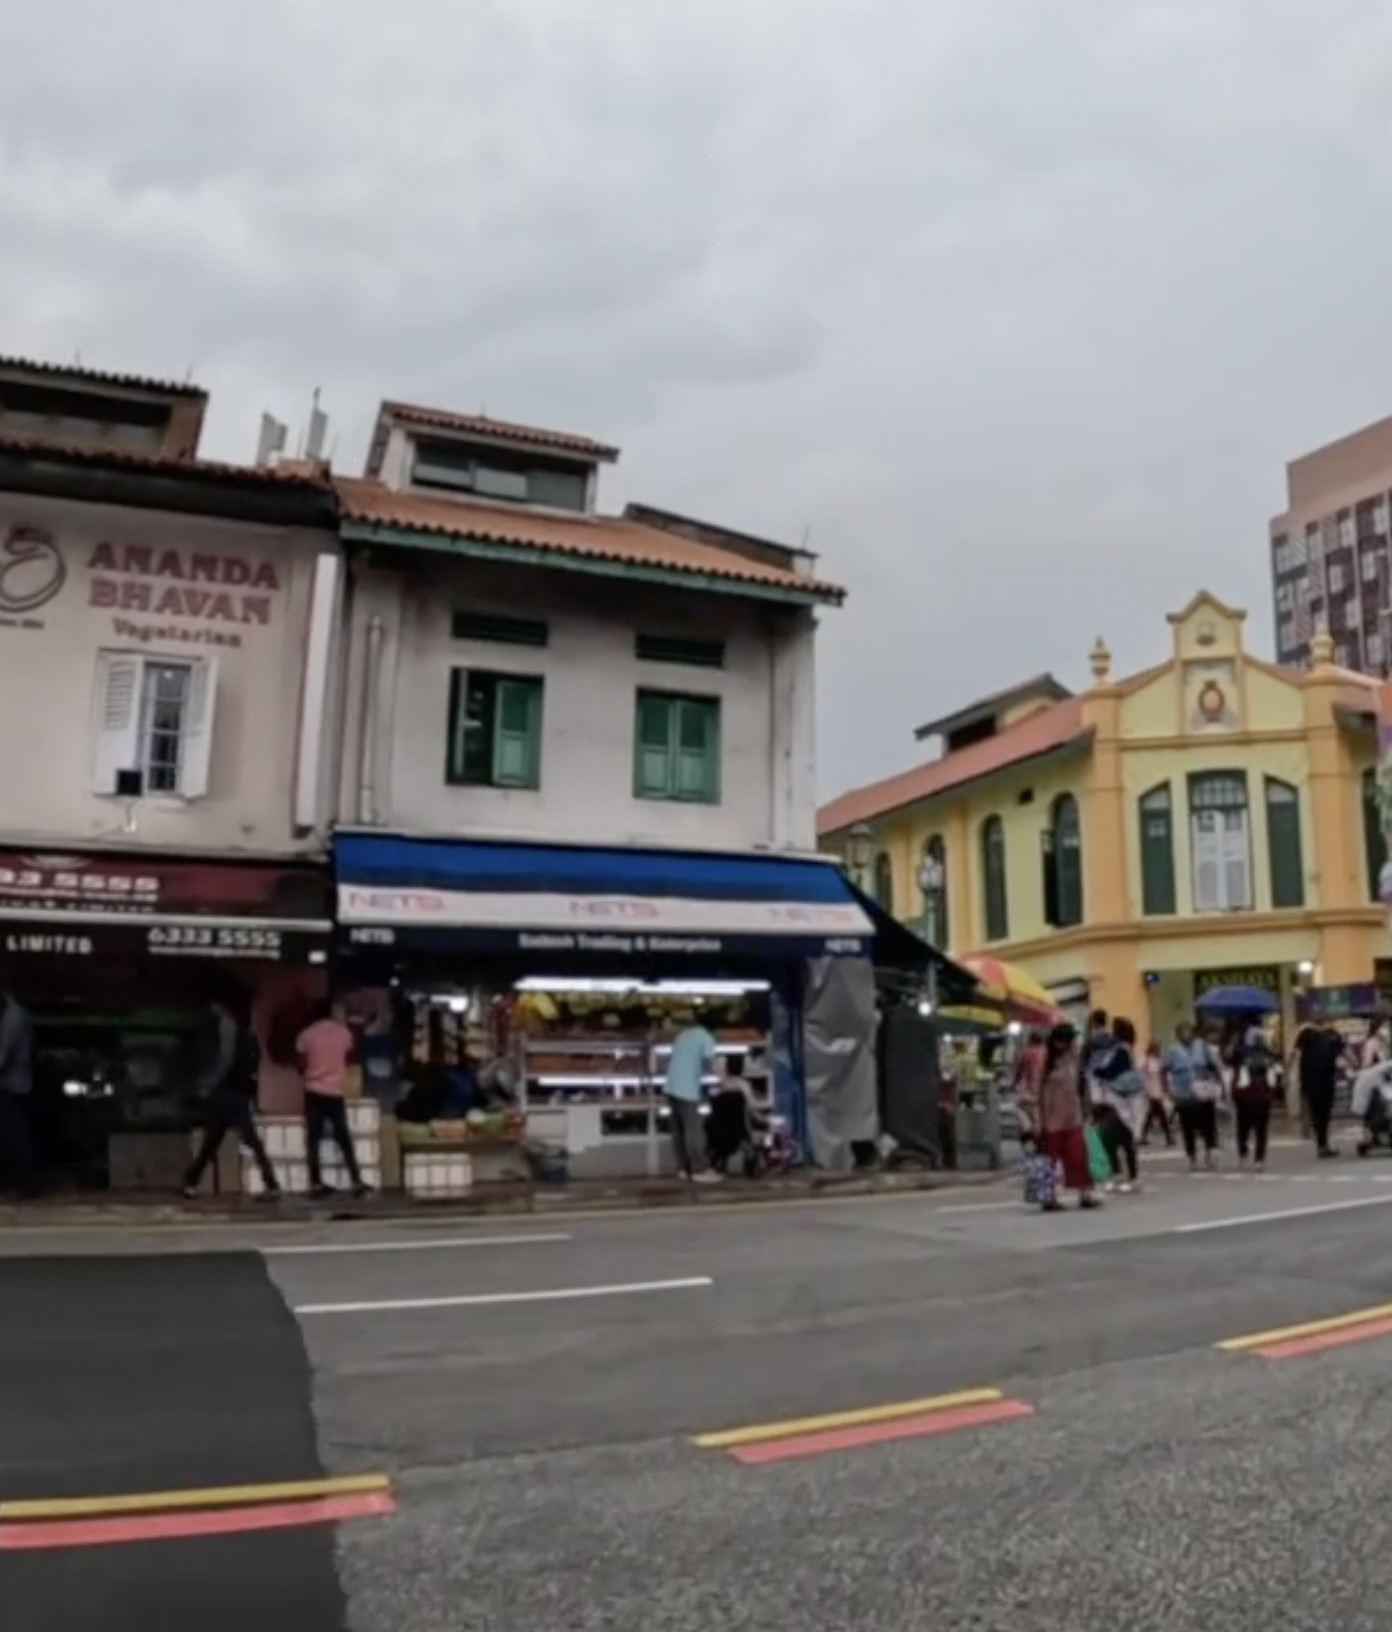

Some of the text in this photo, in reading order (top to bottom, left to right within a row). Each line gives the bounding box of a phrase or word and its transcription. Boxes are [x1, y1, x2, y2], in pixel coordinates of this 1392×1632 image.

[86, 541, 280, 590] ANANDA
[88, 577, 272, 625] BHAVAN
[112, 615, 242, 648] Vegetarian
[54, 872, 158, 892] 5555
[349, 892, 445, 911] NETS
[568, 901, 659, 917] NETS
[6, 934, 94, 955] LIMITED
[147, 926, 281, 948] 6333 5555
[350, 928, 396, 946] NETS
[825, 938, 862, 953] NETS
